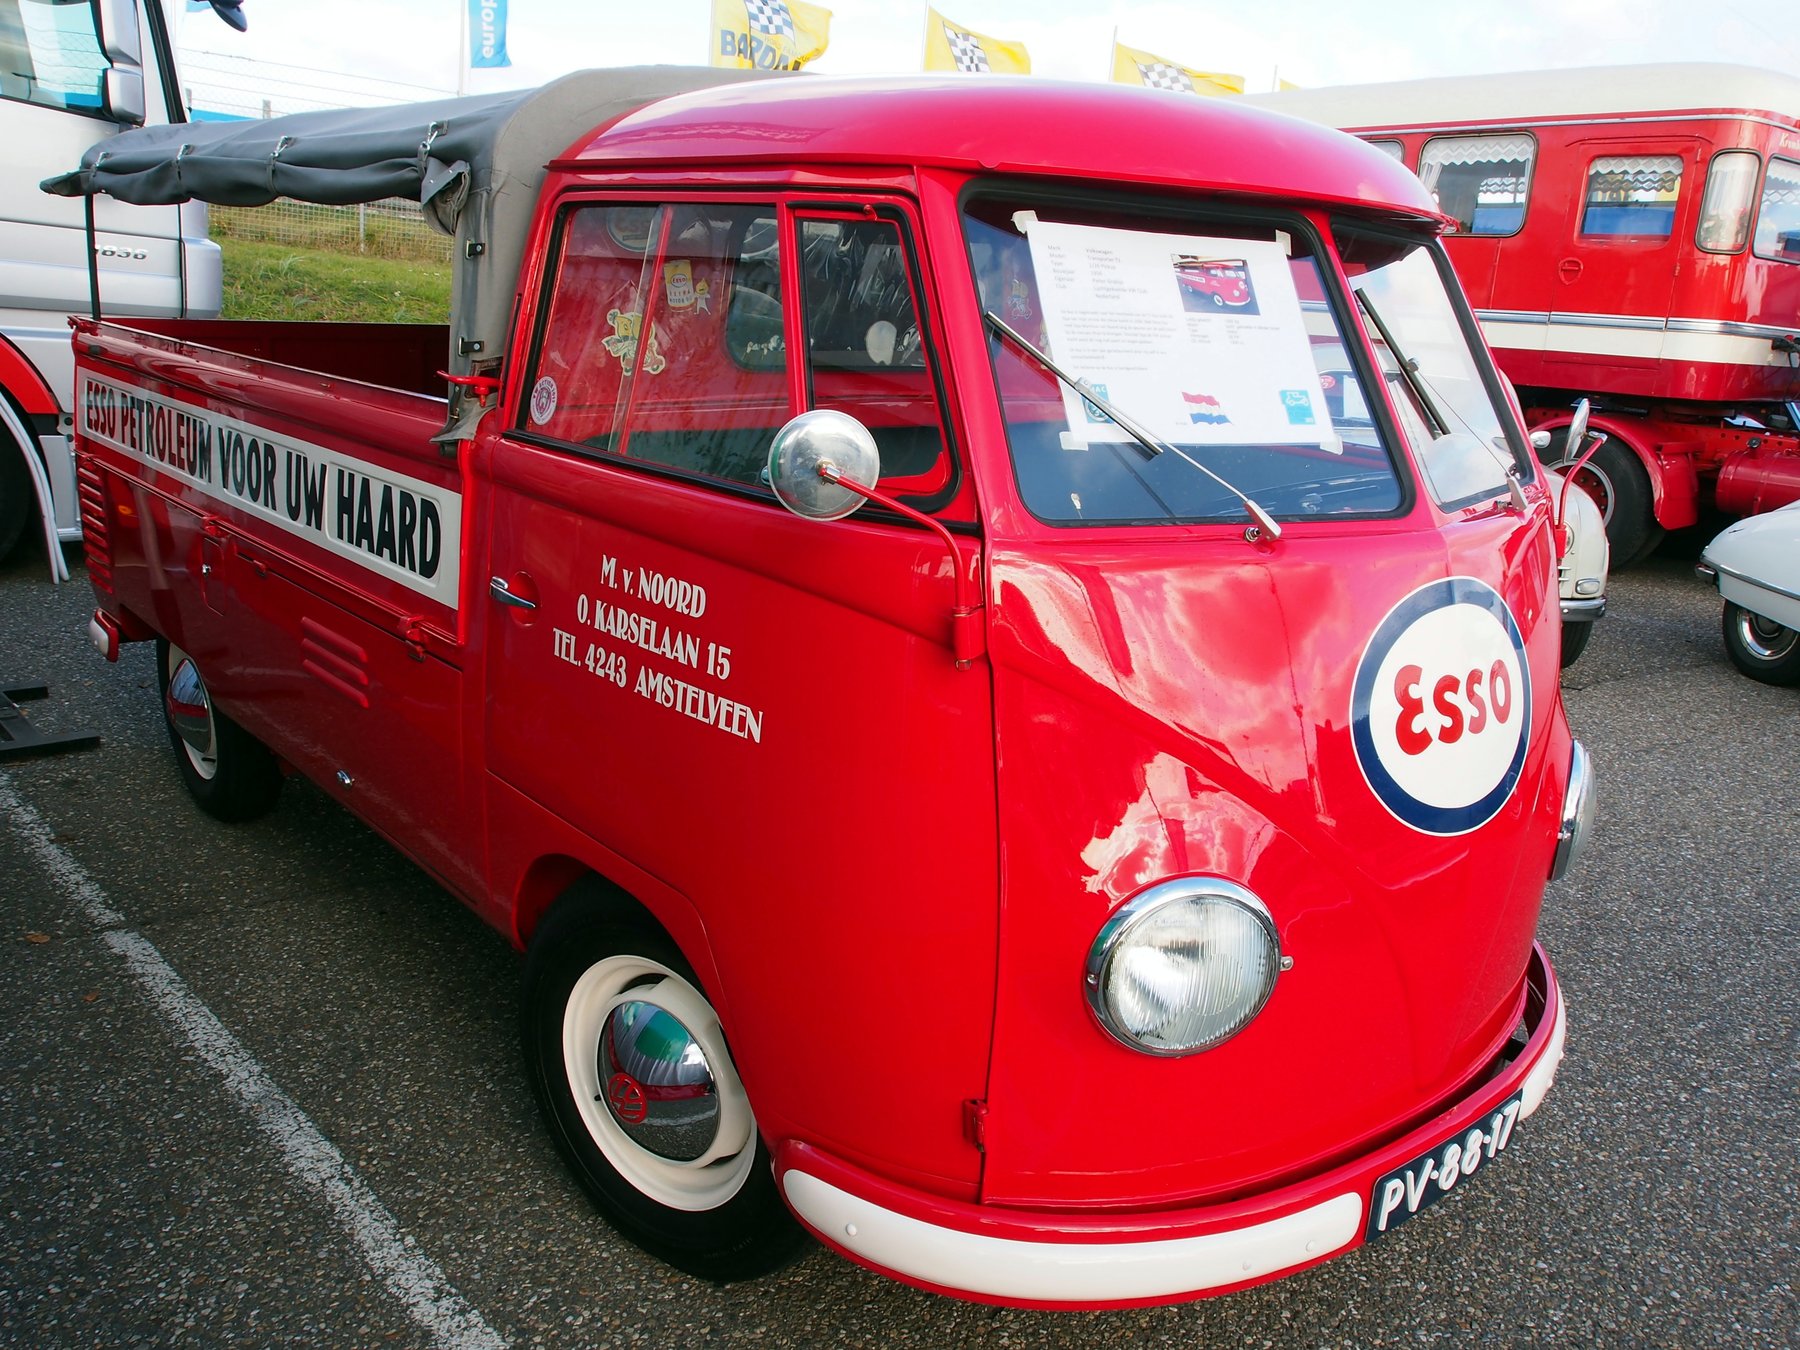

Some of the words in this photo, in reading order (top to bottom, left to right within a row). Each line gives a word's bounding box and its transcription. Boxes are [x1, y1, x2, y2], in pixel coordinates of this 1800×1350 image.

[87, 381, 116, 439] ESSO
[121, 396, 212, 484] PETROLEUM
[218, 427, 277, 511] VOOR
[286, 451, 327, 532] UW
[337, 468, 441, 580] HAARD
[594, 599, 700, 669] KARSELAAN
[706, 642, 731, 681] 15
[637, 567, 706, 618] NOORD
[553, 627, 581, 667] TEL.
[585, 643, 627, 688] 4243
[633, 665, 763, 744] AMSTELVEEN
